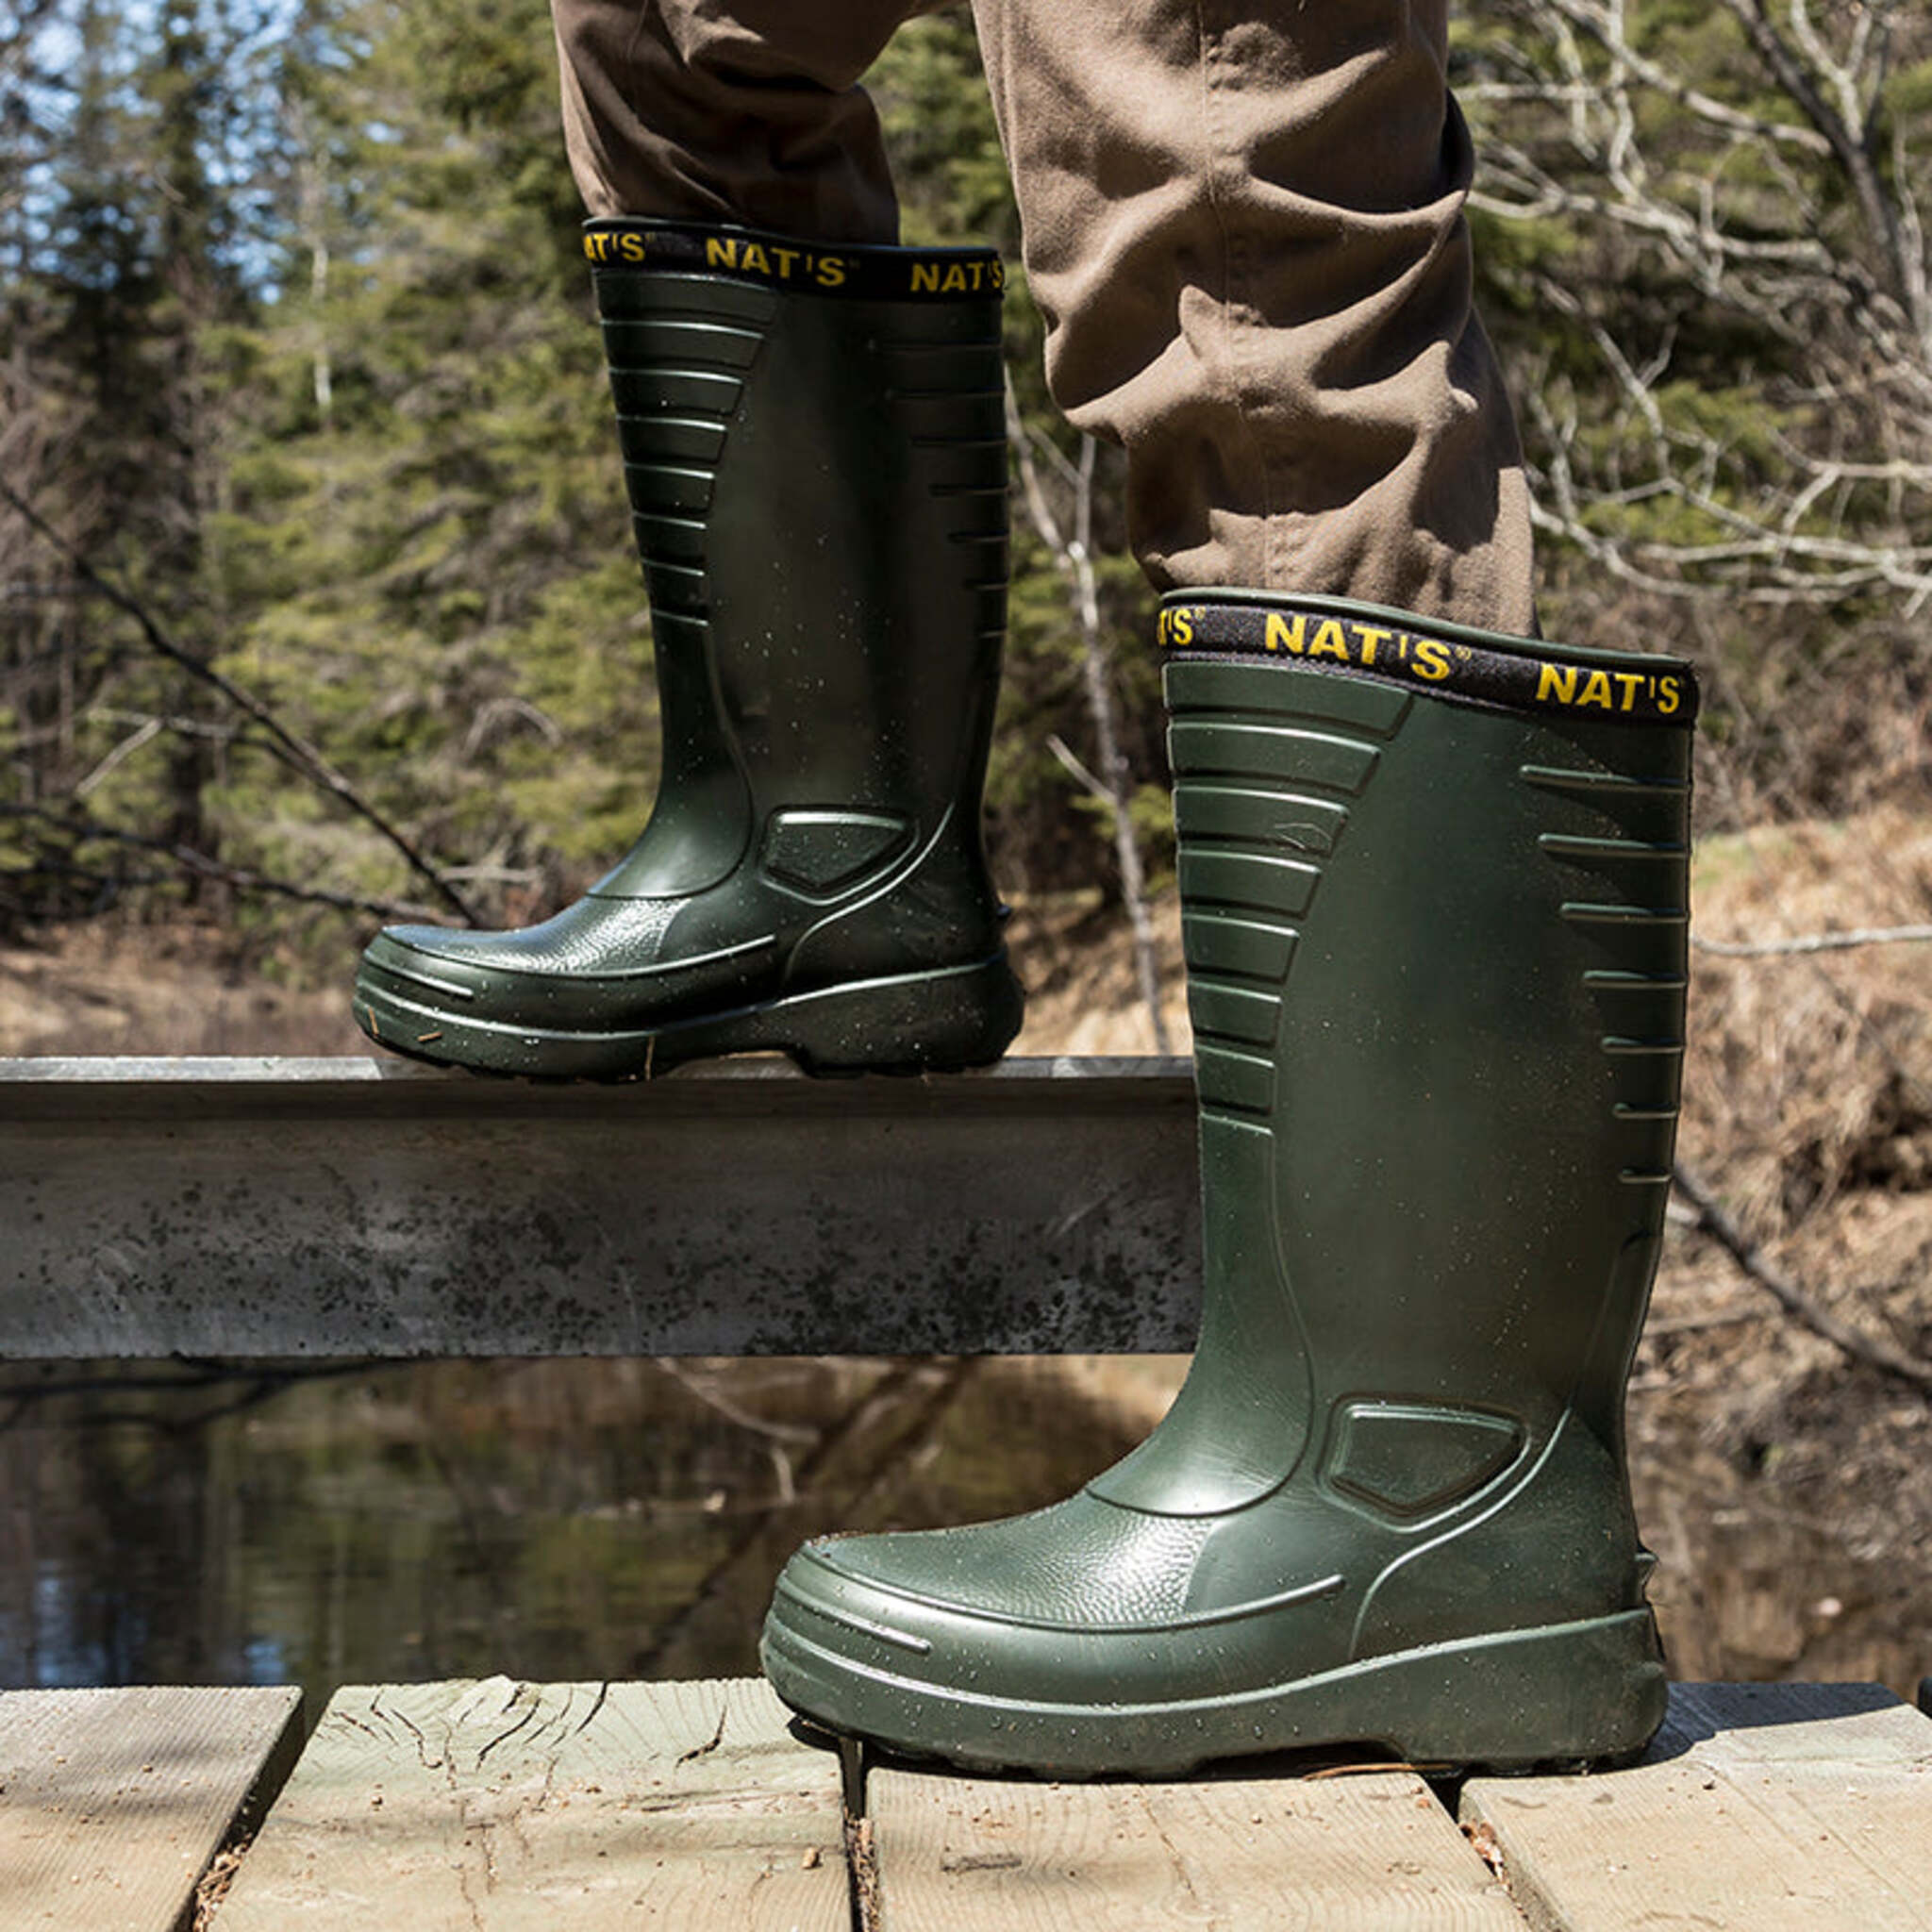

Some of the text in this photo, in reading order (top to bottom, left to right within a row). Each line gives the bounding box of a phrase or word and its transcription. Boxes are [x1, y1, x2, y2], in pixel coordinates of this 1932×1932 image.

[583, 232, 645, 261] AT'S
[706, 237, 845, 287] NAT'S
[1264, 613, 1451, 680] NAT'S
[1535, 663, 1680, 714] NAT'S
